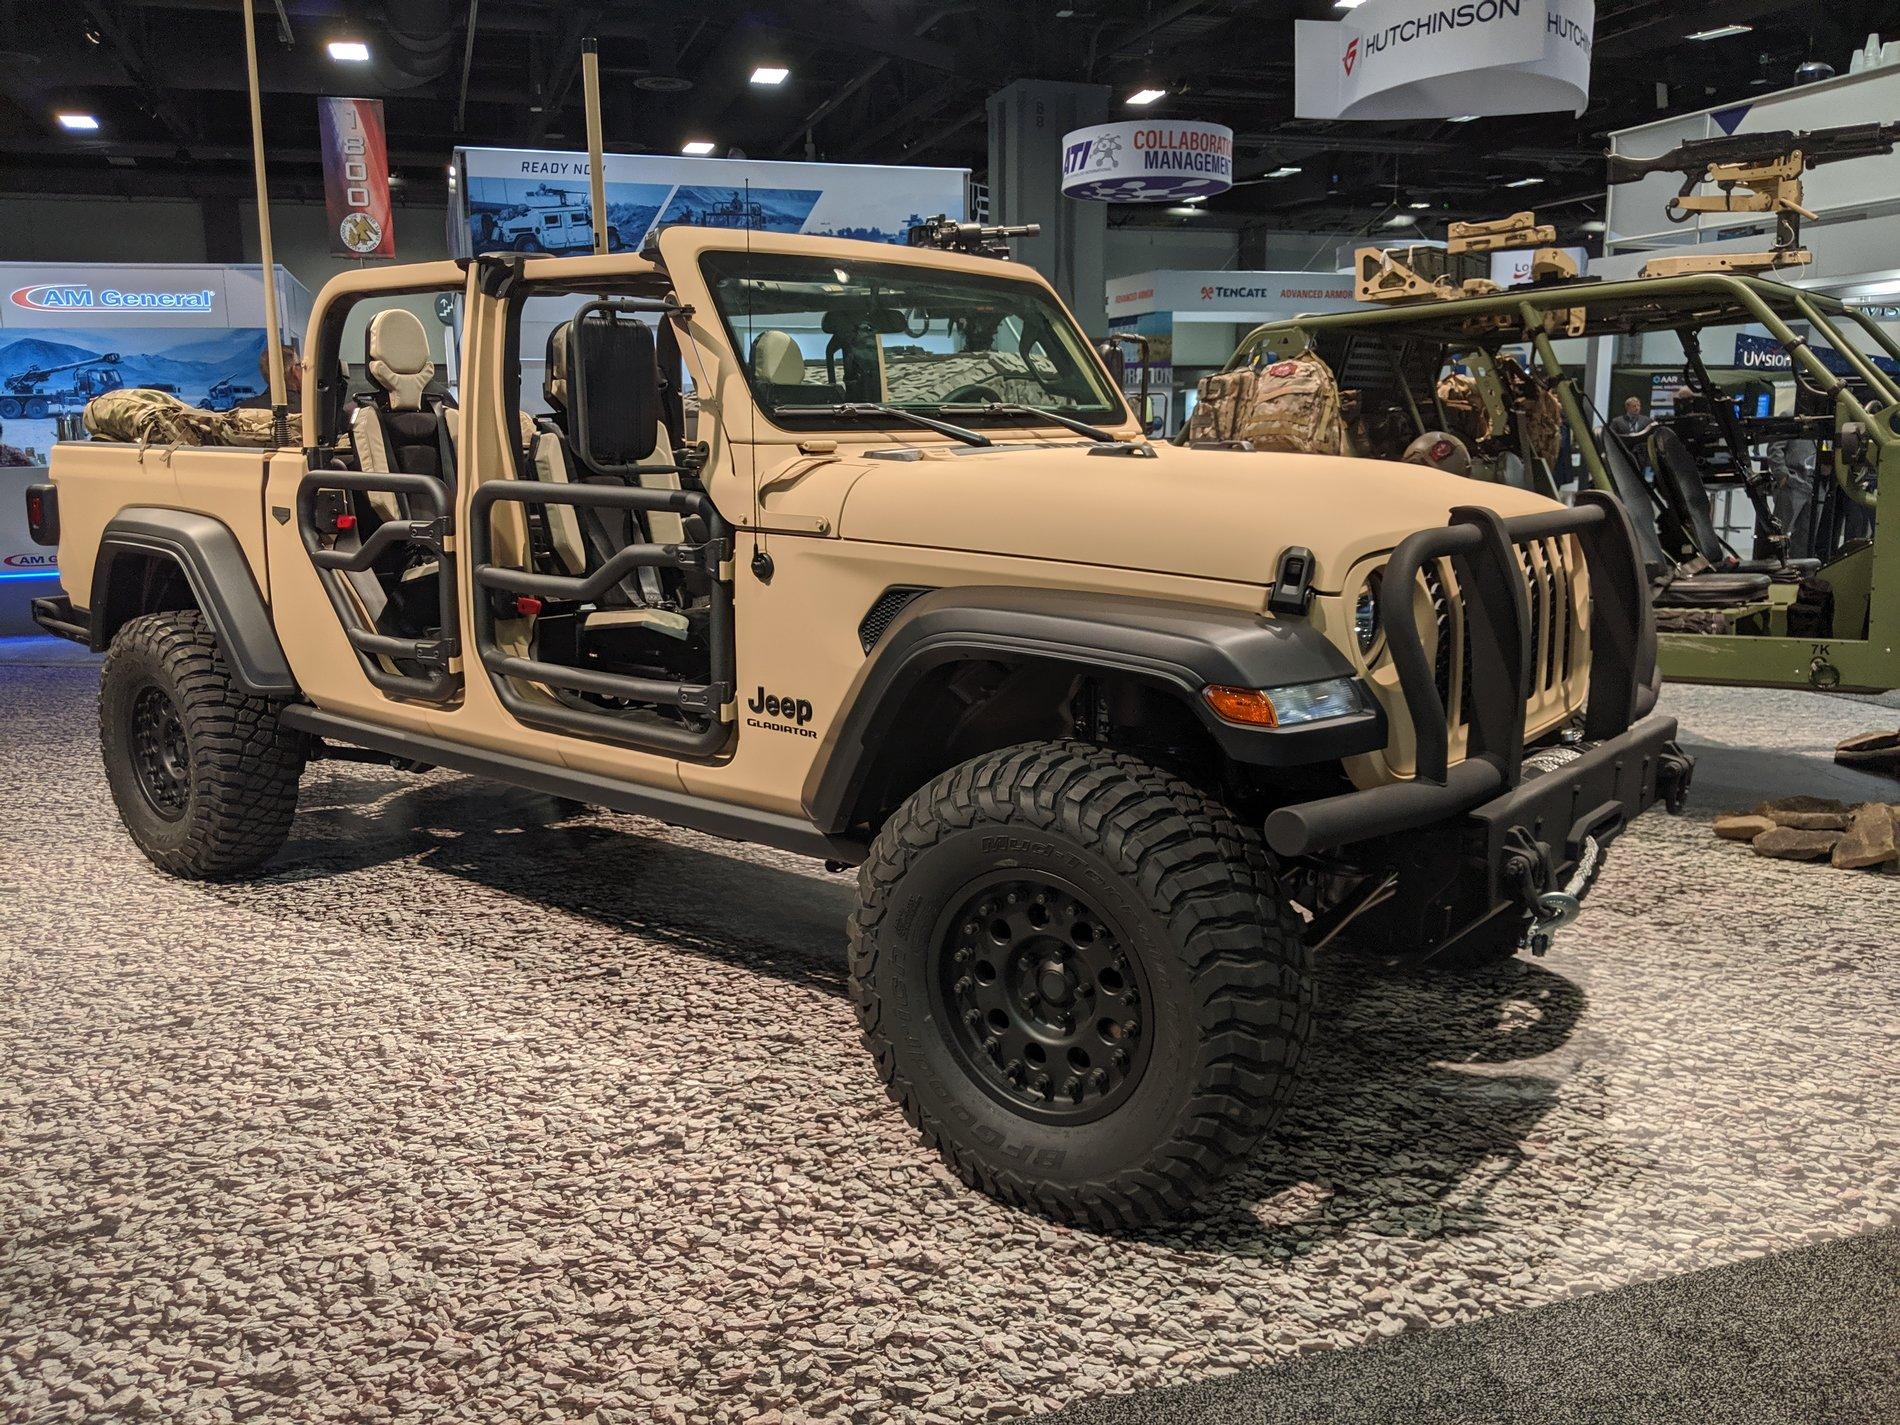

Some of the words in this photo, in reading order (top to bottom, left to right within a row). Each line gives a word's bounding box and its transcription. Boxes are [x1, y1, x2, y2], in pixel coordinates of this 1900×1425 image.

[1365, 0, 1520, 58] HUTCHINSON
[344, 110, 370, 207] 1800
[521, 161, 569, 174] READY
[573, 163, 606, 175] NO
[42, 289, 94, 307] AM
[1280, 289, 1323, 299] ADVANCED
[1660, 375, 1679, 384] AAR
[20, 556, 45, 565] AM
[1811, 644, 1830, 655] 7K
[748, 686, 813, 726] Jeep
[747, 718, 818, 739] GLADIATOR
